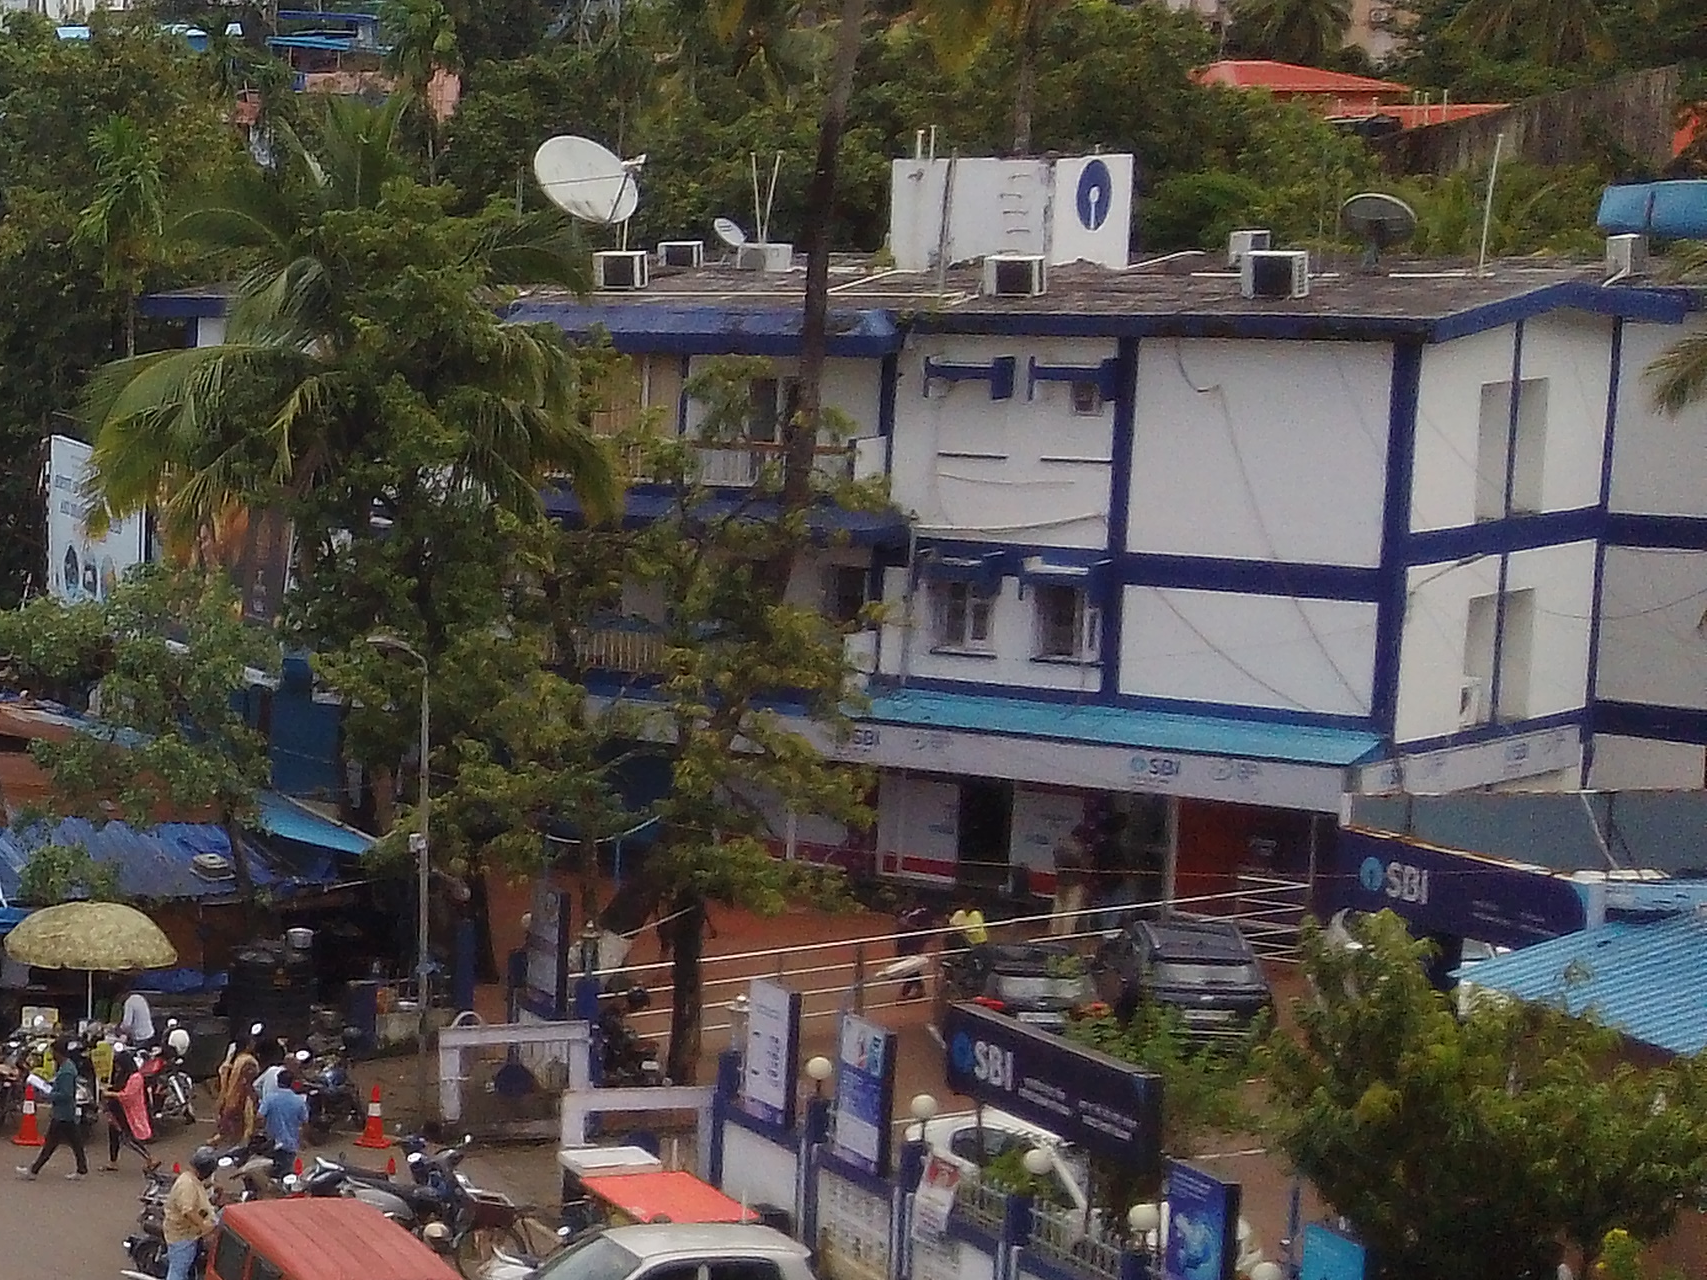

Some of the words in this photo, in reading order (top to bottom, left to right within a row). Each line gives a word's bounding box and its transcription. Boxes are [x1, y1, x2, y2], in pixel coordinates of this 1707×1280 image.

[1148, 758, 1181, 776] SBI
[1386, 860, 1429, 906] SBI
[974, 1040, 1014, 1092] SBI
